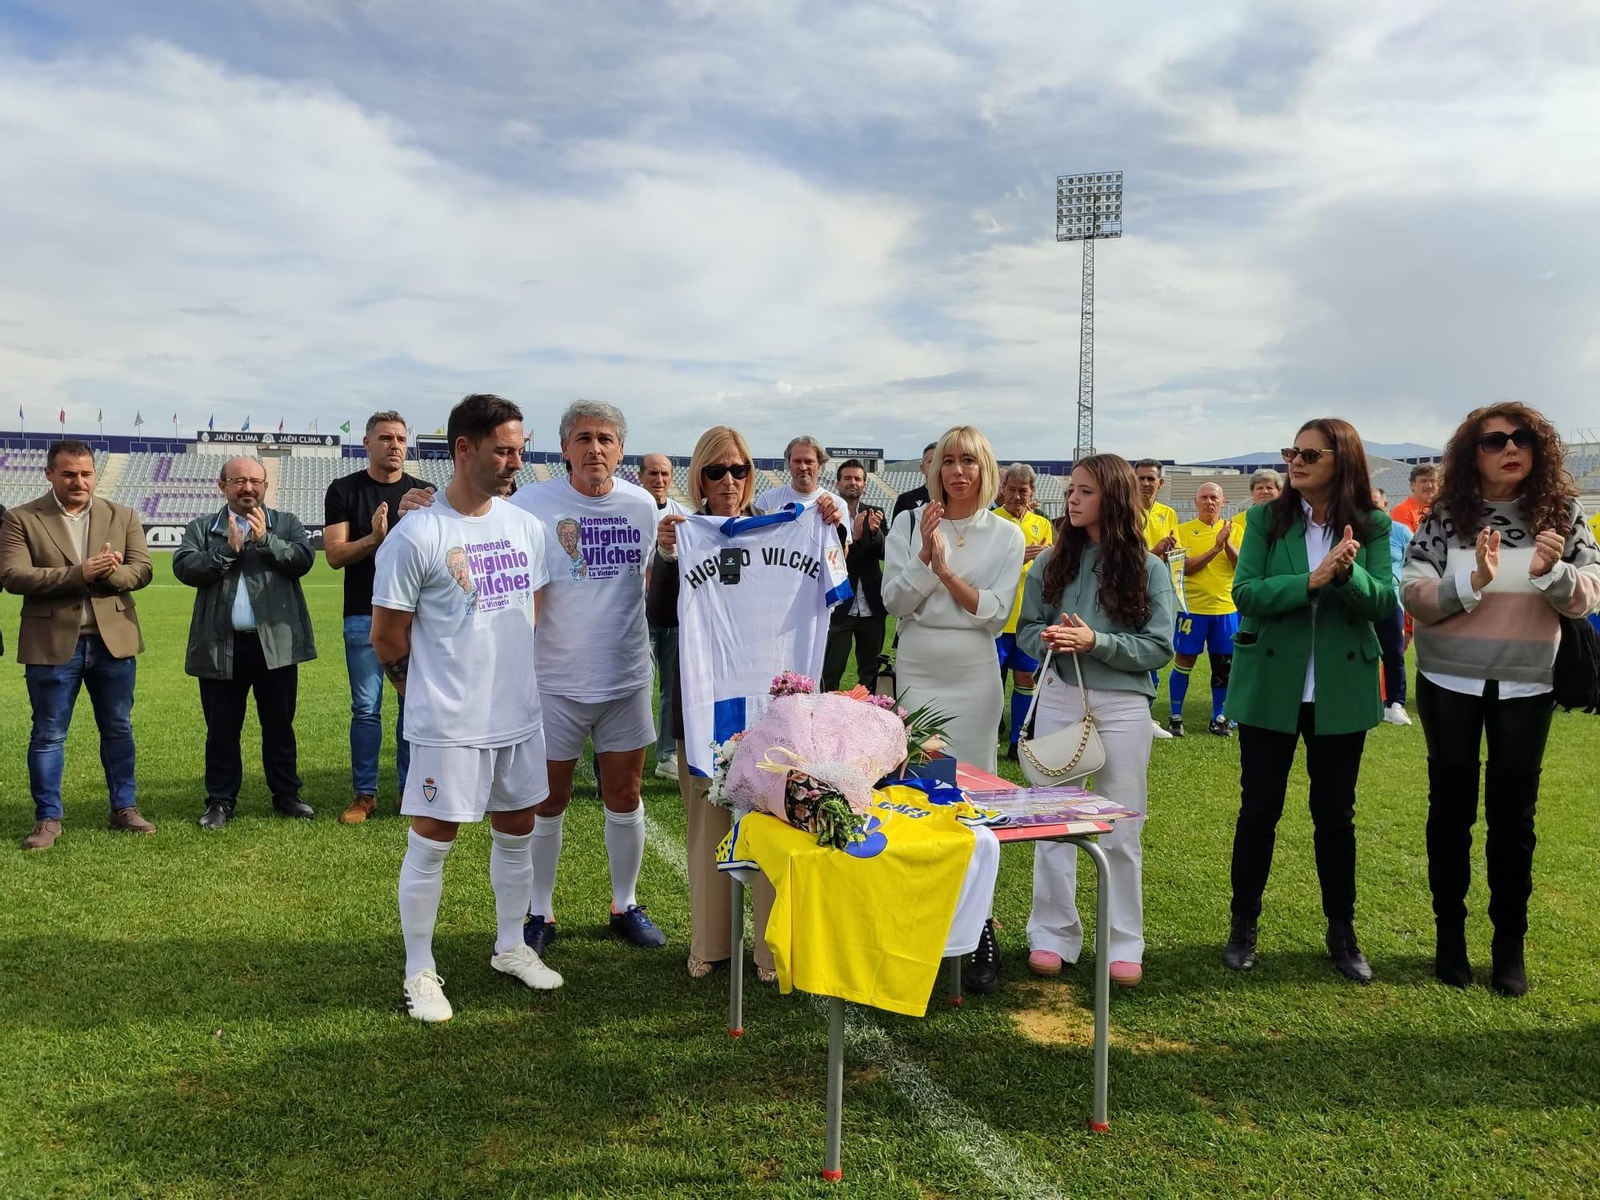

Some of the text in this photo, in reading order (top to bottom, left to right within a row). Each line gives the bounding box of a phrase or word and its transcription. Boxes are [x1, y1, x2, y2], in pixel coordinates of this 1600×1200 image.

[214, 433, 322, 444] JAÉN CLIMA JAÉN CLIMA
[580, 515, 628, 526] Homenaje
[581, 525, 641, 546] Higinio
[464, 538, 512, 555] Homenaje
[582, 546, 642, 566] Vilches
[468, 548, 529, 575] Higinio
[685, 548, 820, 590] HIGIO VILCHE
[474, 572, 531, 597] Vilches
[1178, 617, 1192, 635] 14
